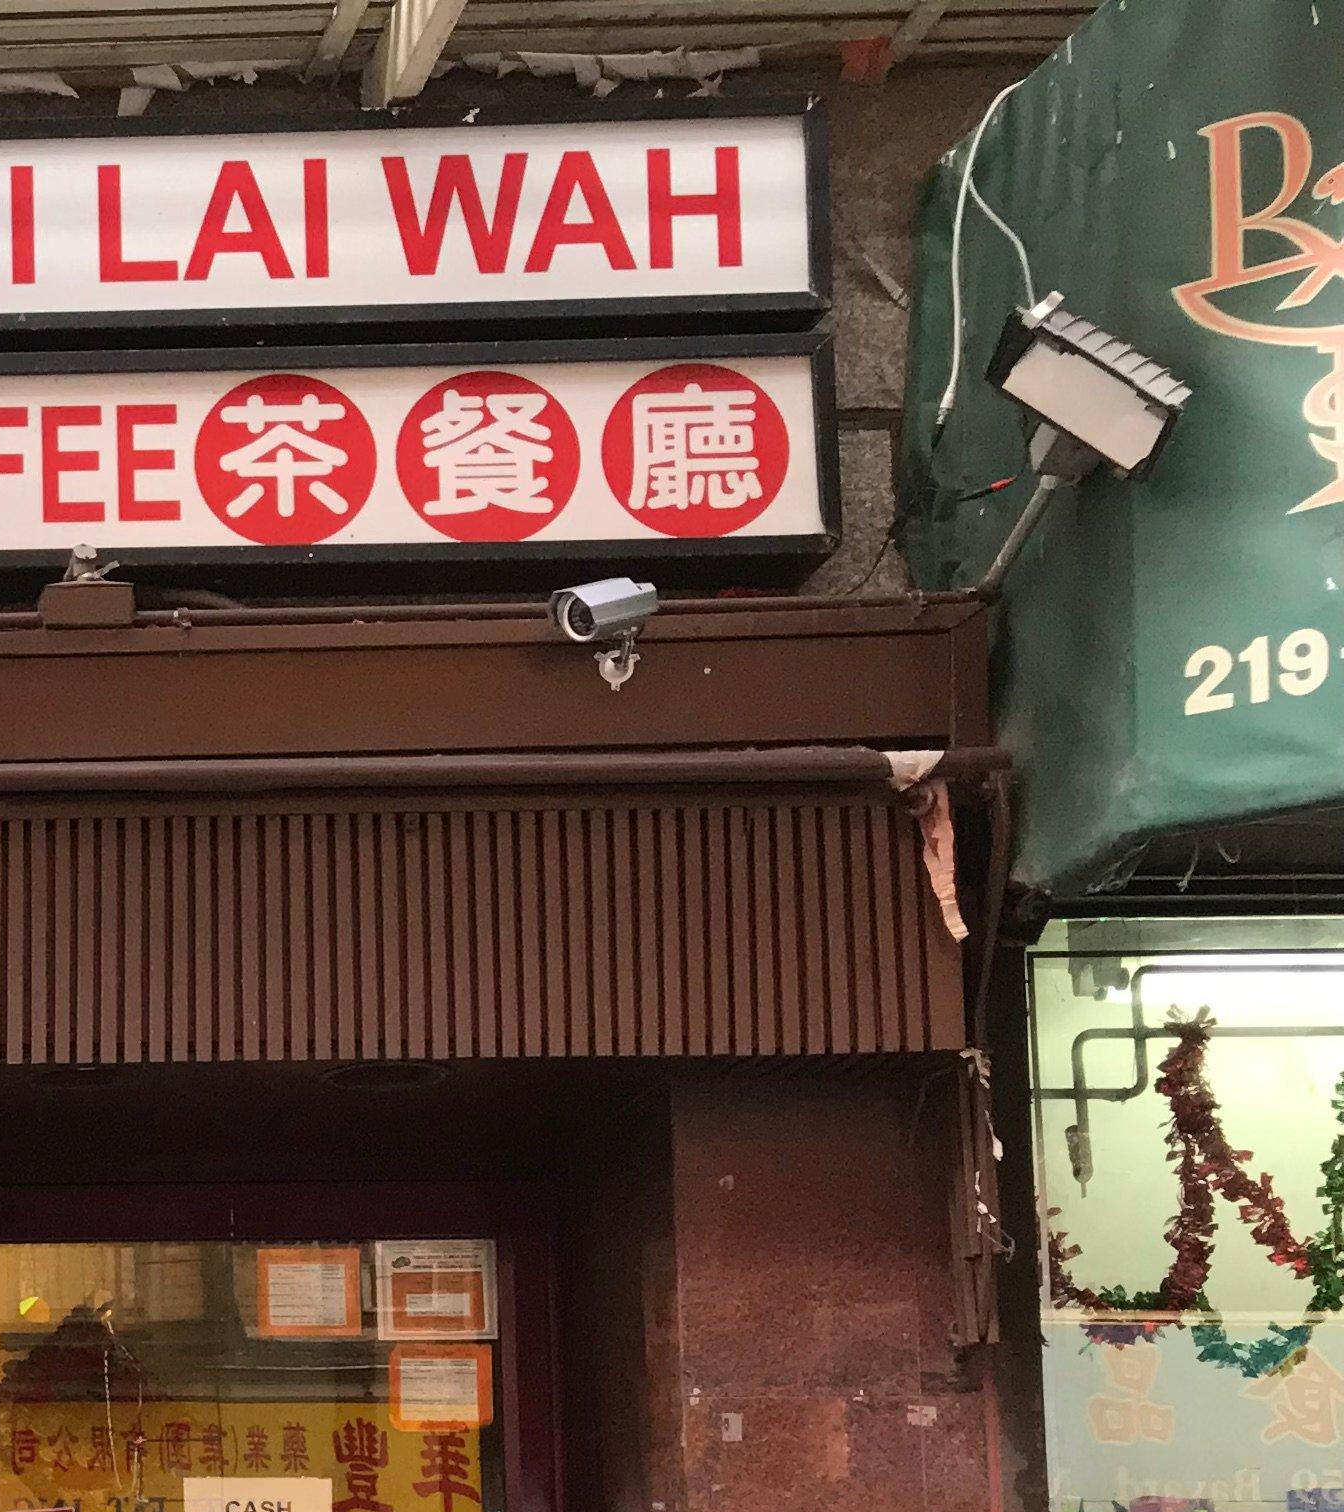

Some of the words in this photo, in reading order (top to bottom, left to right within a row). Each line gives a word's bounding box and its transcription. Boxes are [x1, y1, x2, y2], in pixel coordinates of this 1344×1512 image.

[97, 158, 330, 282] LAI
[382, 146, 742, 275] WAH
[218, 388, 764, 518] 茶餐廳
